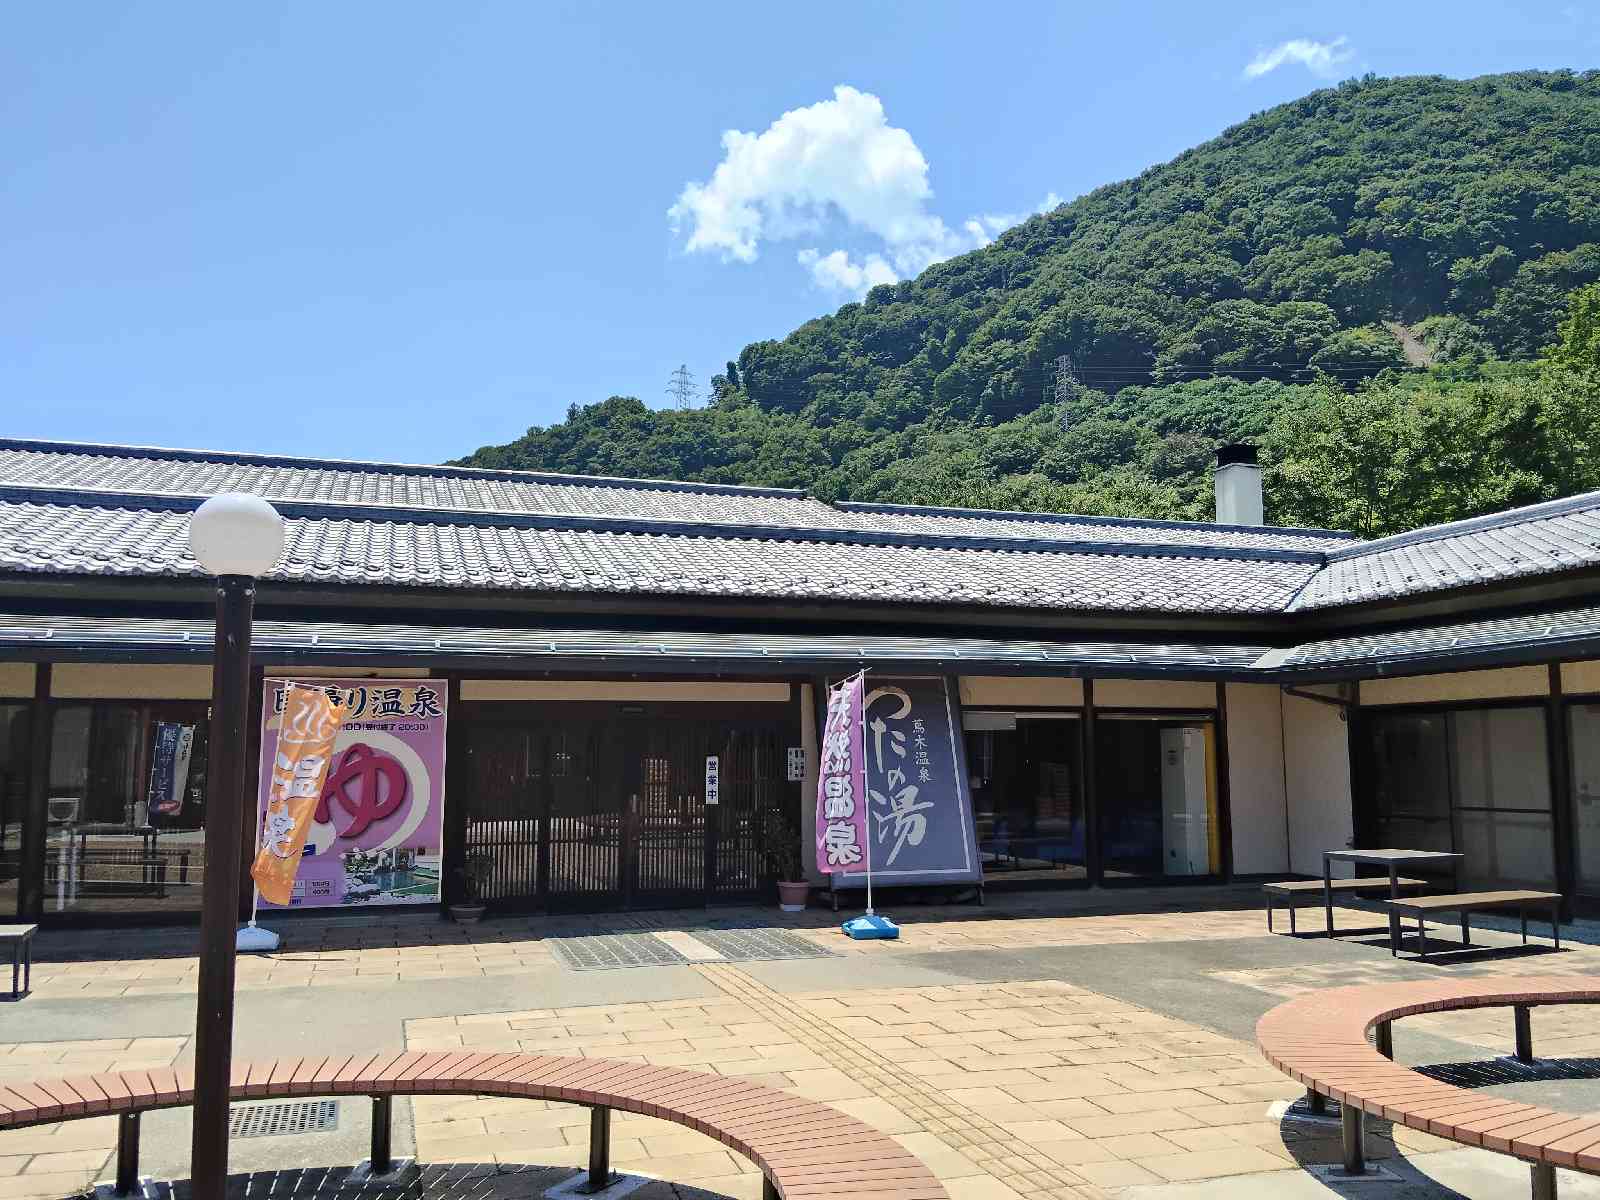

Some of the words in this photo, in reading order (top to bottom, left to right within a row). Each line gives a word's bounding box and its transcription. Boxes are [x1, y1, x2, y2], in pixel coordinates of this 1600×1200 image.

[314, 742, 407, 838] ゆ
[707, 760, 718, 800] 営業中
[823, 686, 862, 865] 天然温泉
[864, 686, 934, 866] つたの湯
